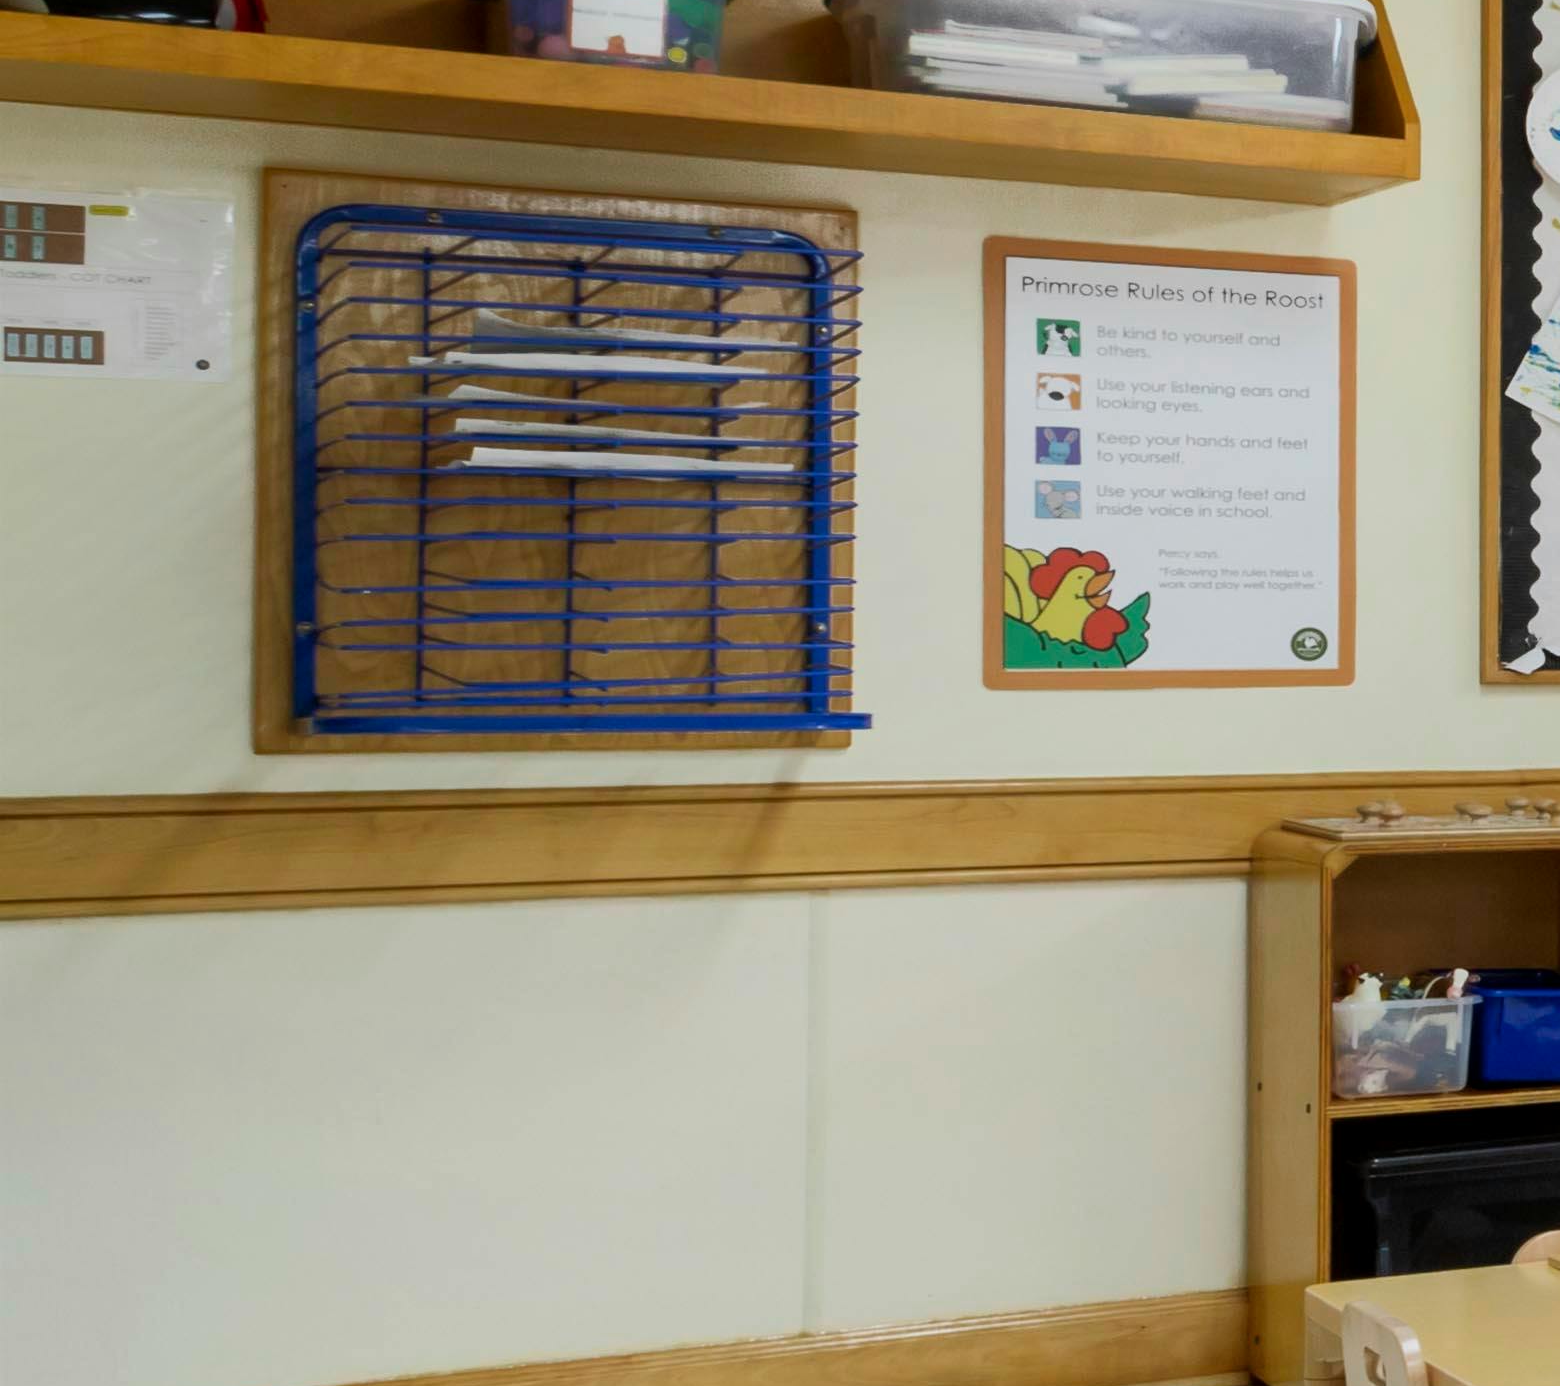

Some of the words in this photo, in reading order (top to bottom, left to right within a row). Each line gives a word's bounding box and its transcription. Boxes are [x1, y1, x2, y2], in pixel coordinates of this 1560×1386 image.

[1022, 276, 1119, 299] Primrose
[1128, 282, 1185, 303] Rules
[1192, 286, 1214, 303] of
[1222, 288, 1257, 306] the
[1266, 290, 1324, 310] Roost
[1097, 325, 1118, 339] Be
[1122, 326, 1157, 341] kind
[1162, 328, 1178, 342] to
[1182, 329, 1243, 346] yourself
[1248, 332, 1281, 347] and
[1097, 344, 1151, 359] others.
[1097, 379, 1126, 392] Use
[1131, 382, 1166, 396] your
[1170, 380, 1236, 398] listening
[1240, 386, 1274, 398] ears
[1278, 386, 1311, 399] and
[1096, 397, 1157, 413] looking
[1161, 400, 1203, 413] eyes.
[1096, 433, 1141, 447] Keep
[1145, 435, 1181, 449] your
[1185, 434, 1236, 449] hands
[1240, 436, 1273, 450] and
[1276, 437, 1309, 450] feet
[1096, 451, 1113, 462] to
[1118, 451, 1185, 465] yourself.
[1096, 485, 1126, 498] Use
[1130, 487, 1166, 500] your
[1170, 487, 1233, 503] walking
[1237, 487, 1270, 501] feet
[1273, 488, 1306, 502] and
[1096, 504, 1143, 517] inside
[1147, 506, 1194, 518] voice
[1198, 505, 1213, 518] in
[1216, 505, 1273, 519] school.
